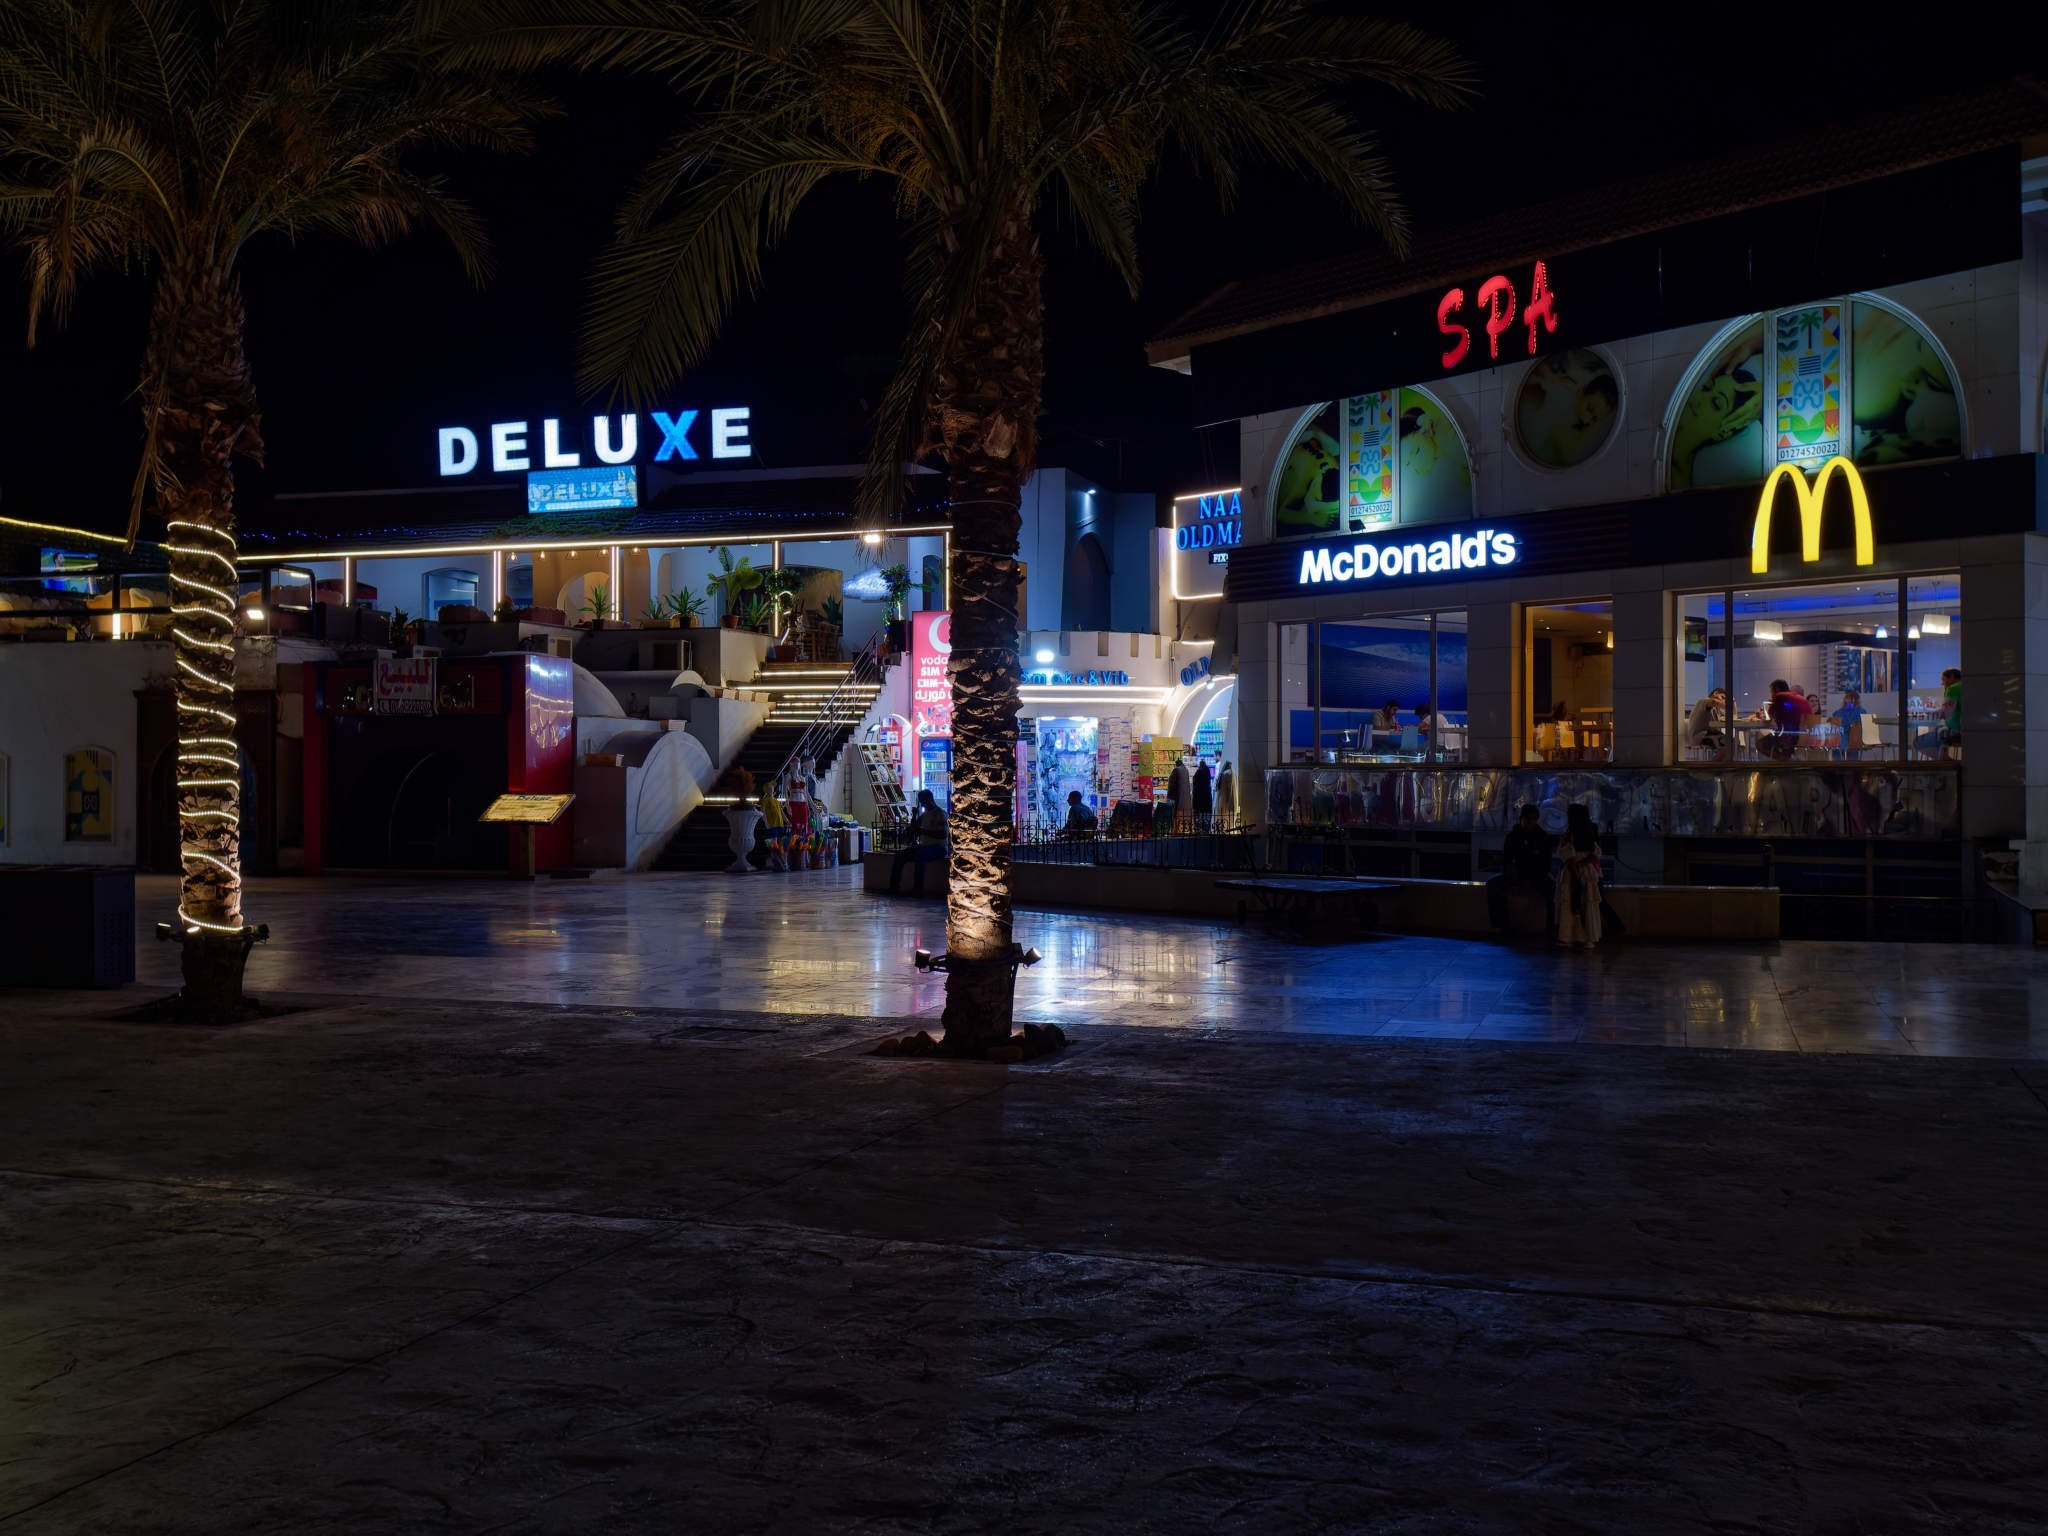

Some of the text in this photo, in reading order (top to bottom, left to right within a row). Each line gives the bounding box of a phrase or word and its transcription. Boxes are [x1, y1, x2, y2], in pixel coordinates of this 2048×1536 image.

[1437, 260, 1558, 369] SPA
[438, 407, 752, 477] DELUXE
[1298, 528, 1518, 585] McDonald's
